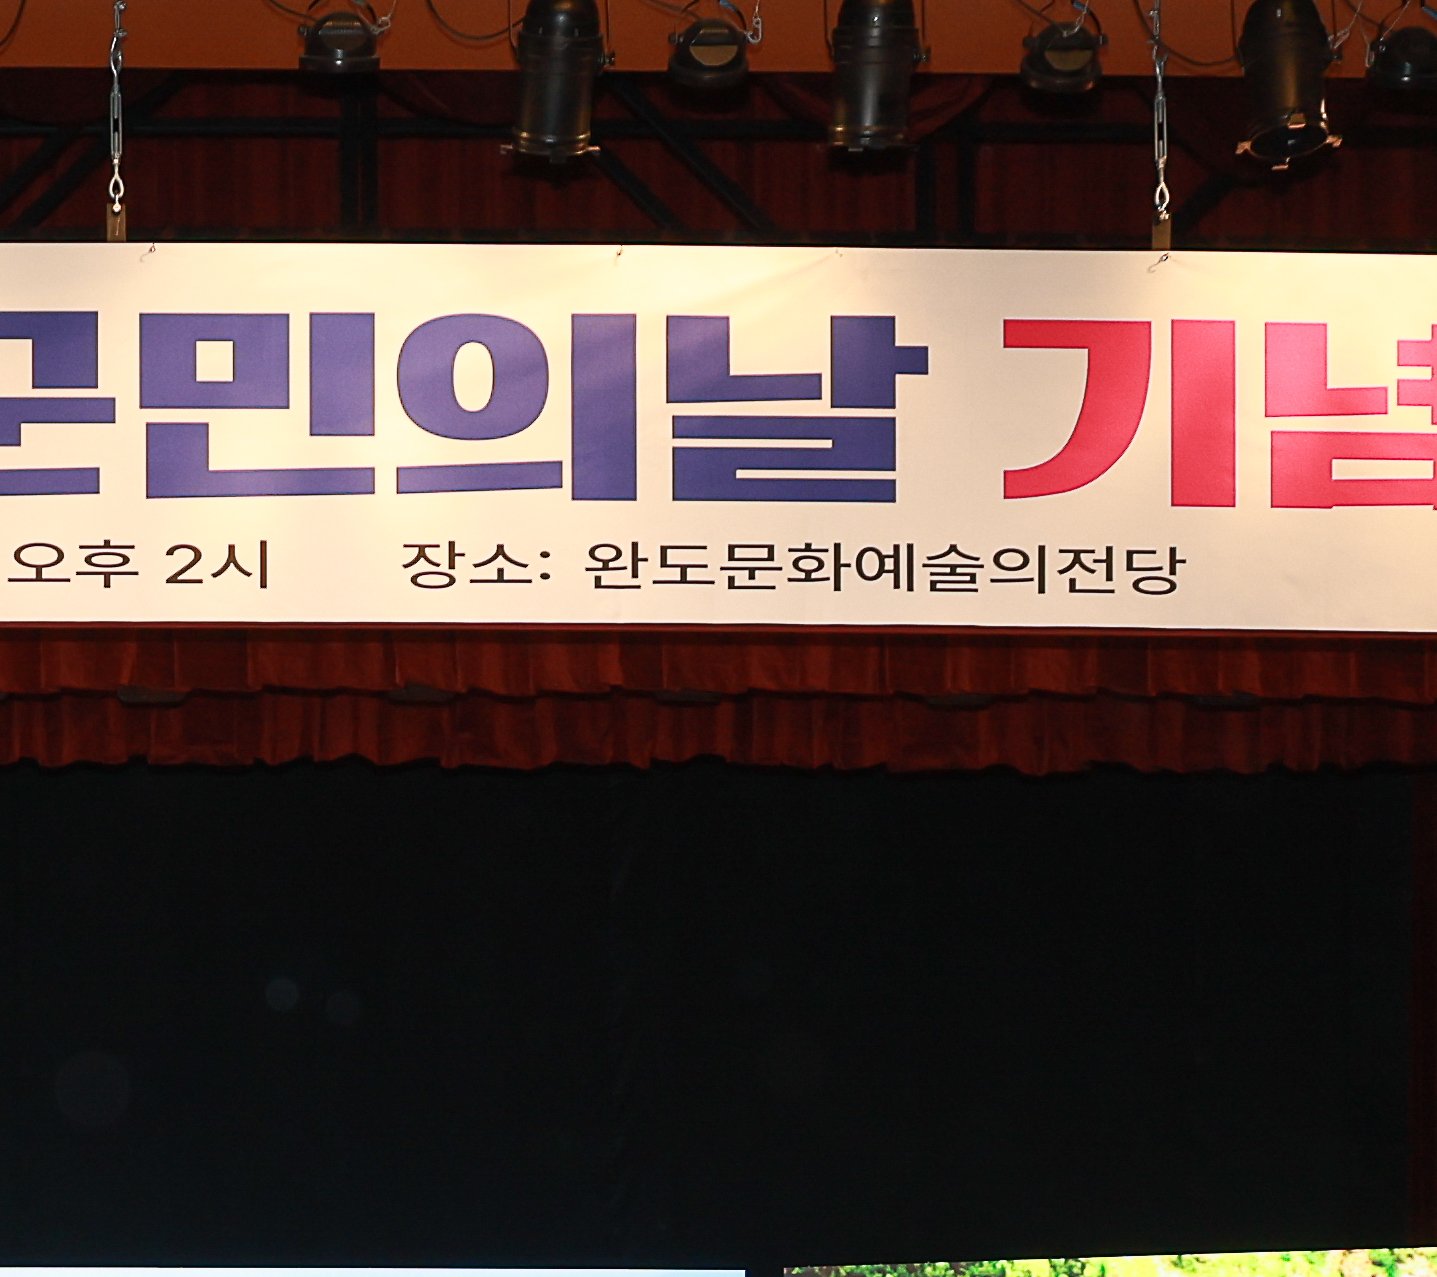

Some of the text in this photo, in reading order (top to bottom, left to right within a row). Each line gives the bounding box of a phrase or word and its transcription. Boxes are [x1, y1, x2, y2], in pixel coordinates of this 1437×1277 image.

[6, 539, 141, 592] 오후
[163, 539, 271, 592] 2시
[400, 540, 552, 592] 장소:
[582, 540, 1187, 596] 완도문화예술의전당
